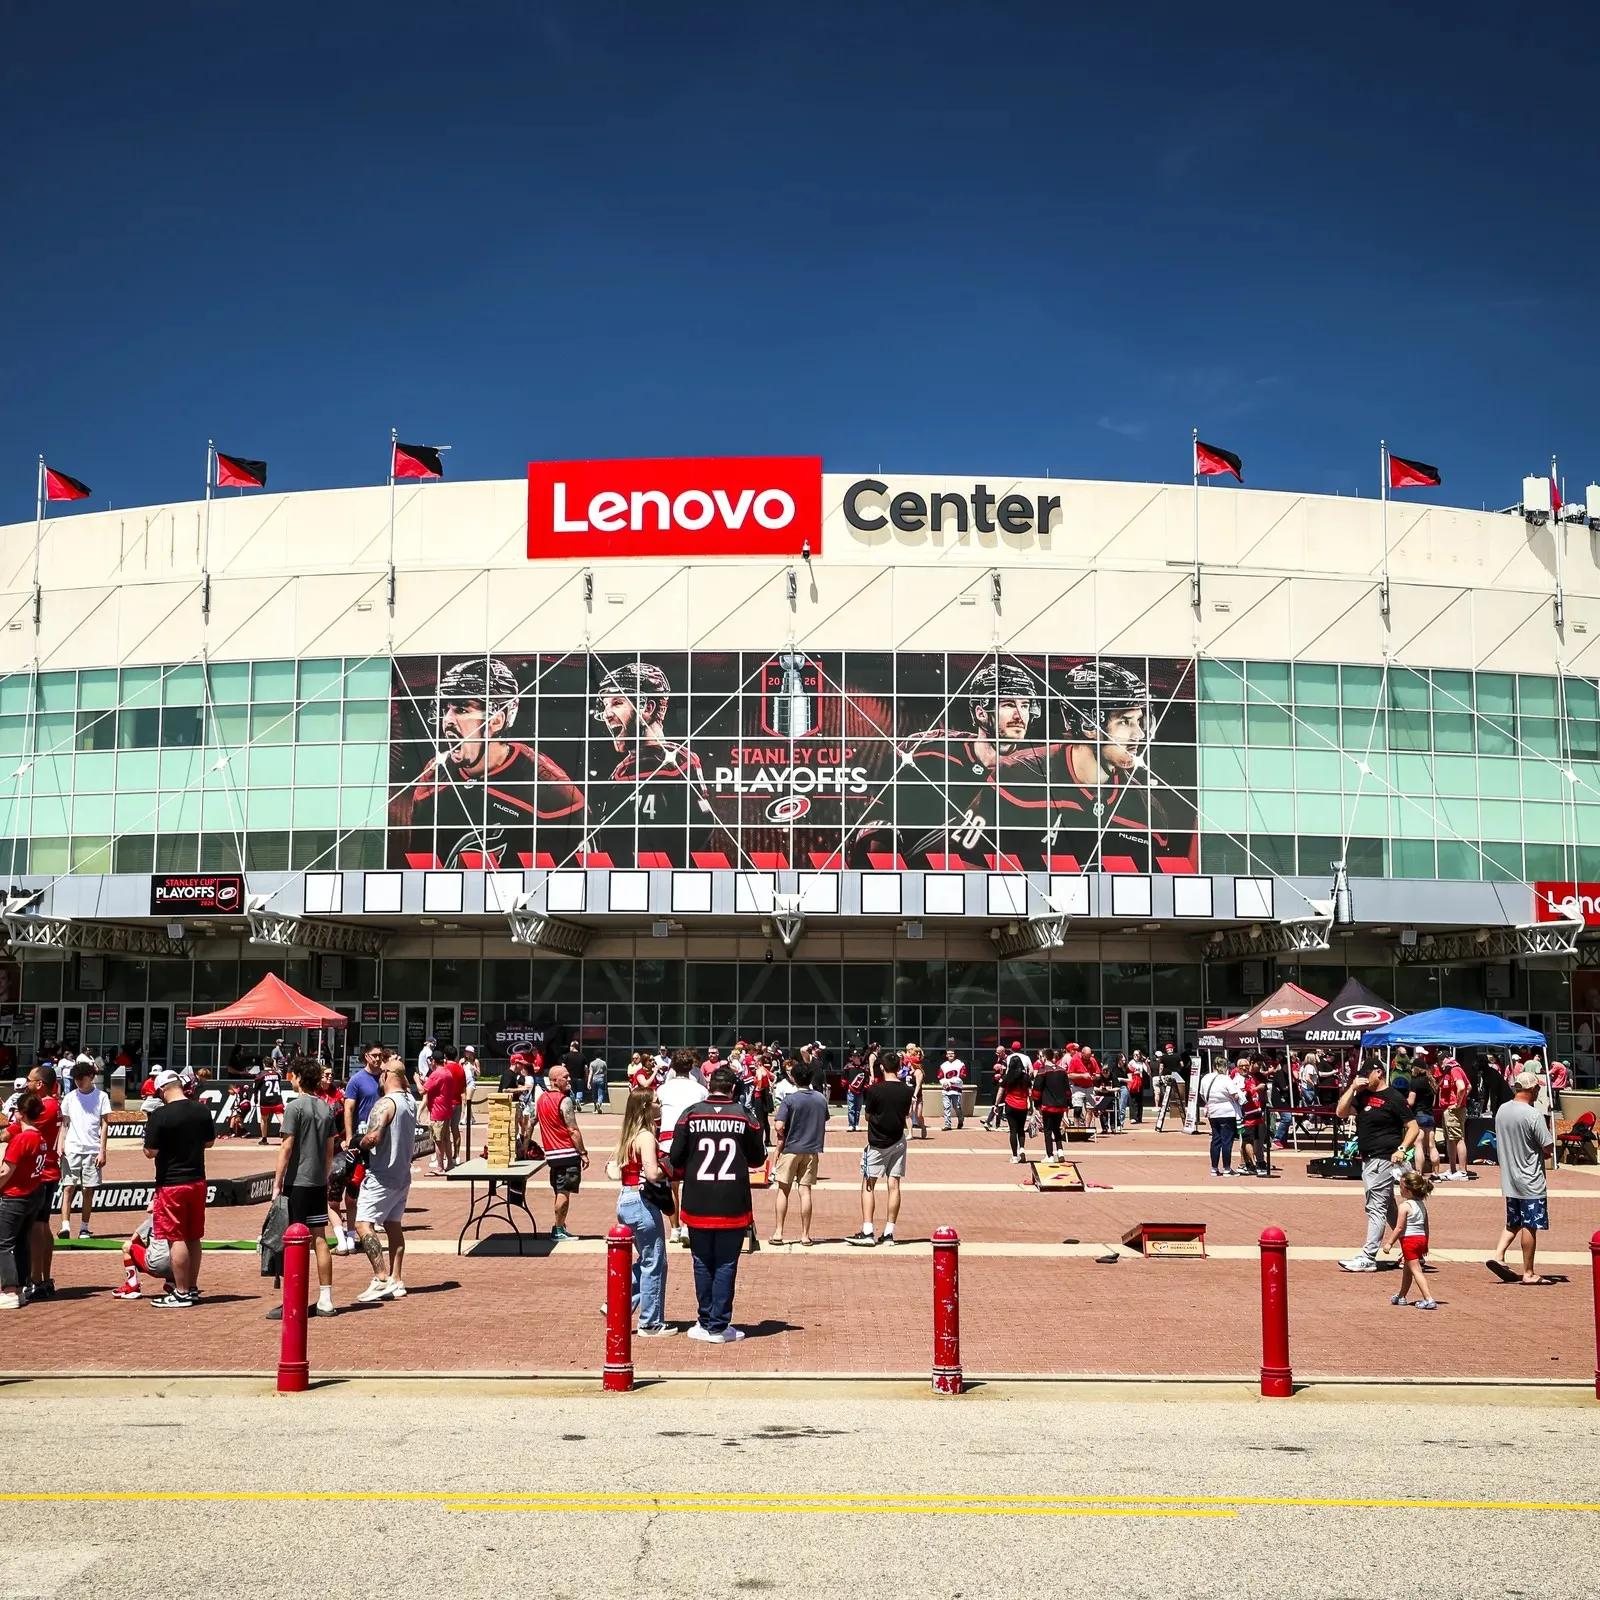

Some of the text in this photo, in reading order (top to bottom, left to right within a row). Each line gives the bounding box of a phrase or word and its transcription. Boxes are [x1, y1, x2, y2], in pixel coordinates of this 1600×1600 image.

[552, 478, 1061, 535] Lenovo Center
[768, 677, 816, 686] 20 26
[730, 747, 855, 765] STANLEY CUP
[715, 766, 868, 793] PLAYOFFS
[951, 809, 986, 849] 20
[165, 879, 198, 887] STANLEY
[156, 887, 215, 899] PLAYOFFS
[1548, 890, 1600, 914] Len
[496, 1032, 544, 1041] SIREN
[1305, 1030, 1361, 1041] CAROLINA
[265, 1081, 280, 1097] 24
[689, 1120, 746, 1134] STANKOVEN
[697, 1138, 736, 1181] 22
[250, 1178, 273, 1199] CAROLI
